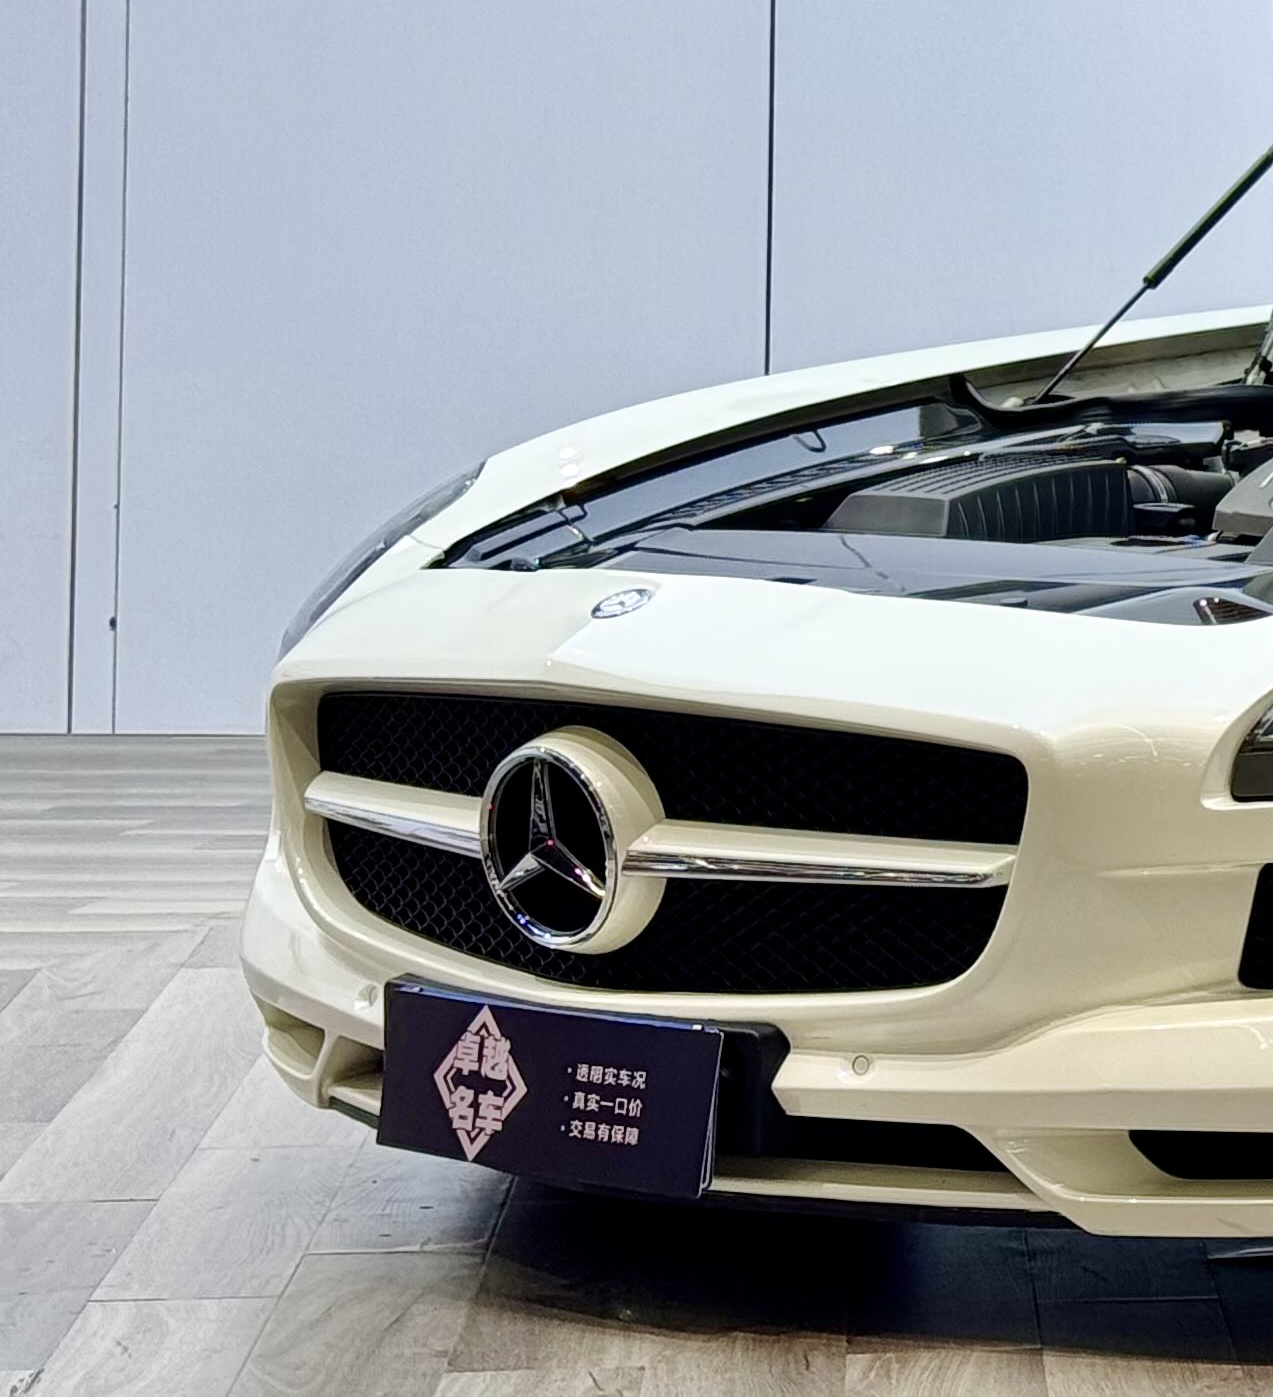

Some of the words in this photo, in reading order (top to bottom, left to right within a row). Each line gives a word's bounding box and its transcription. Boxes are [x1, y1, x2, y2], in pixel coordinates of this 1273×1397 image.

[453, 1030, 512, 1081] 卓越
[576, 1063, 647, 1090] 透明实车况
[448, 1085, 504, 1136] 名车
[572, 1091, 643, 1118] 真实一口价
[568, 1119, 640, 1146] 交易有保障
